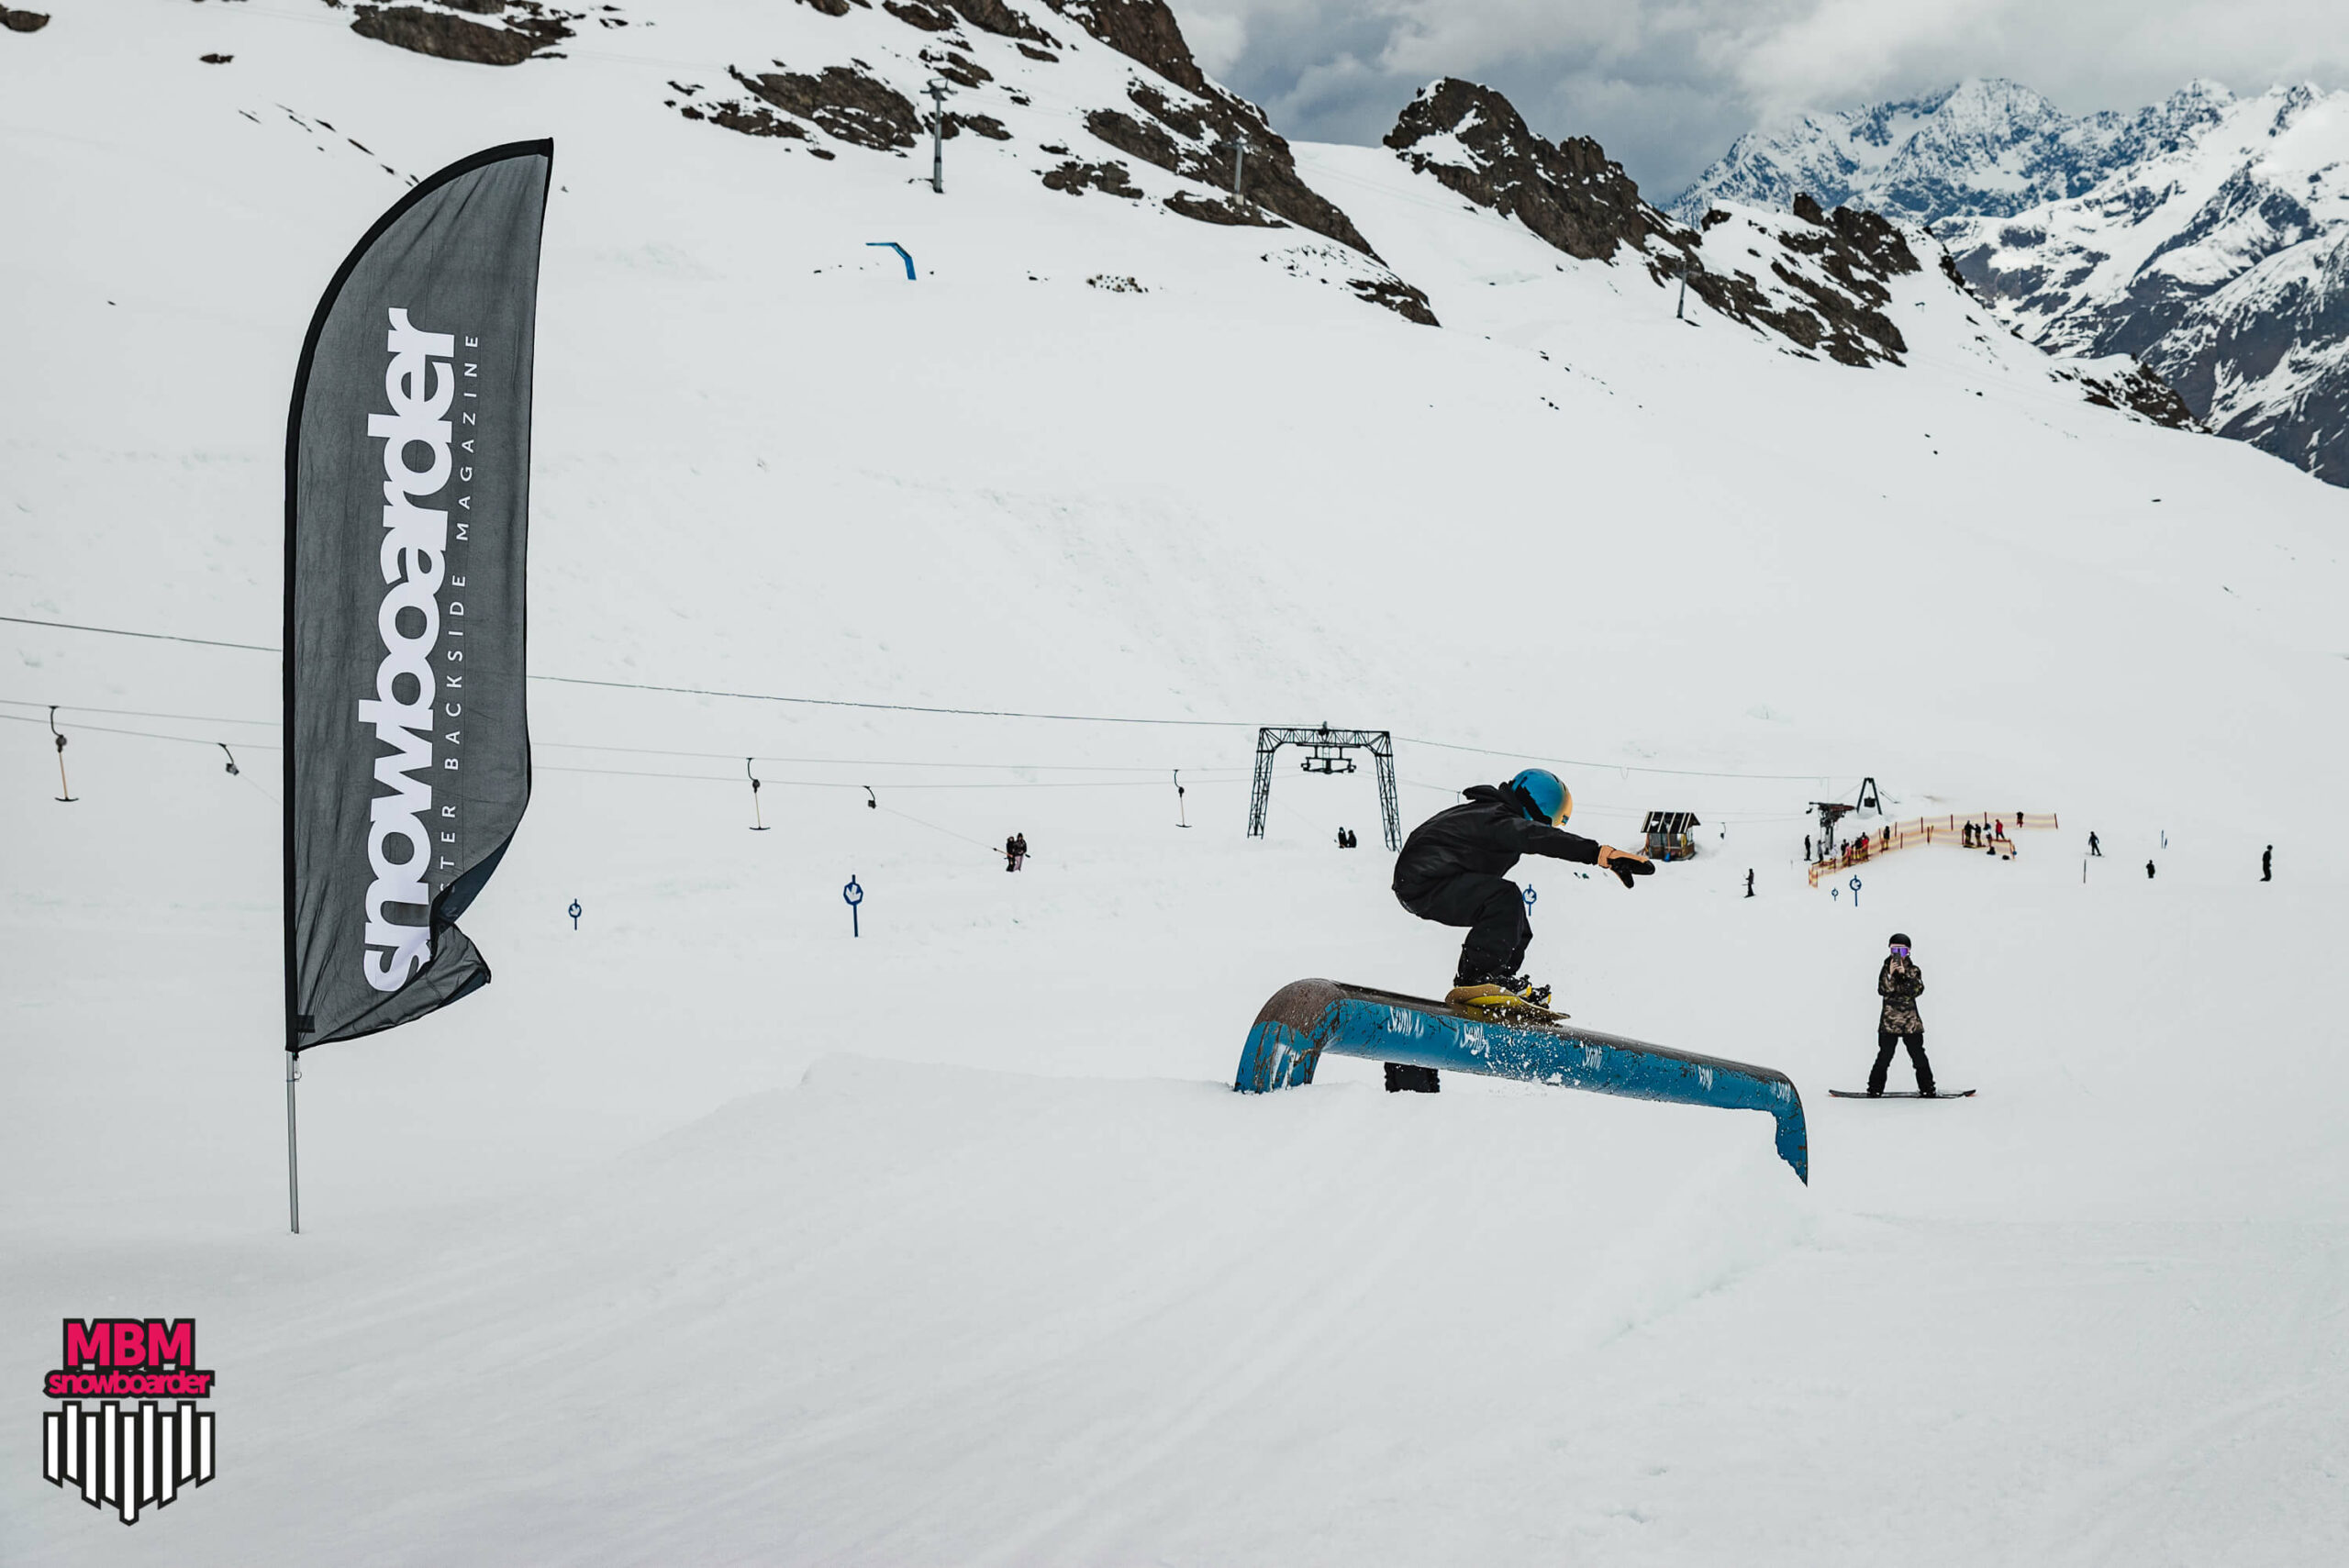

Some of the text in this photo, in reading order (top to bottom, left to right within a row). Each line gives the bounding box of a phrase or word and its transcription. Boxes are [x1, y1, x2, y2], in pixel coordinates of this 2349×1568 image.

[359, 307, 455, 992] snowboarder
[444, 574, 466, 771] BACKSIDE
[456, 335, 479, 541] MAGAZINE
